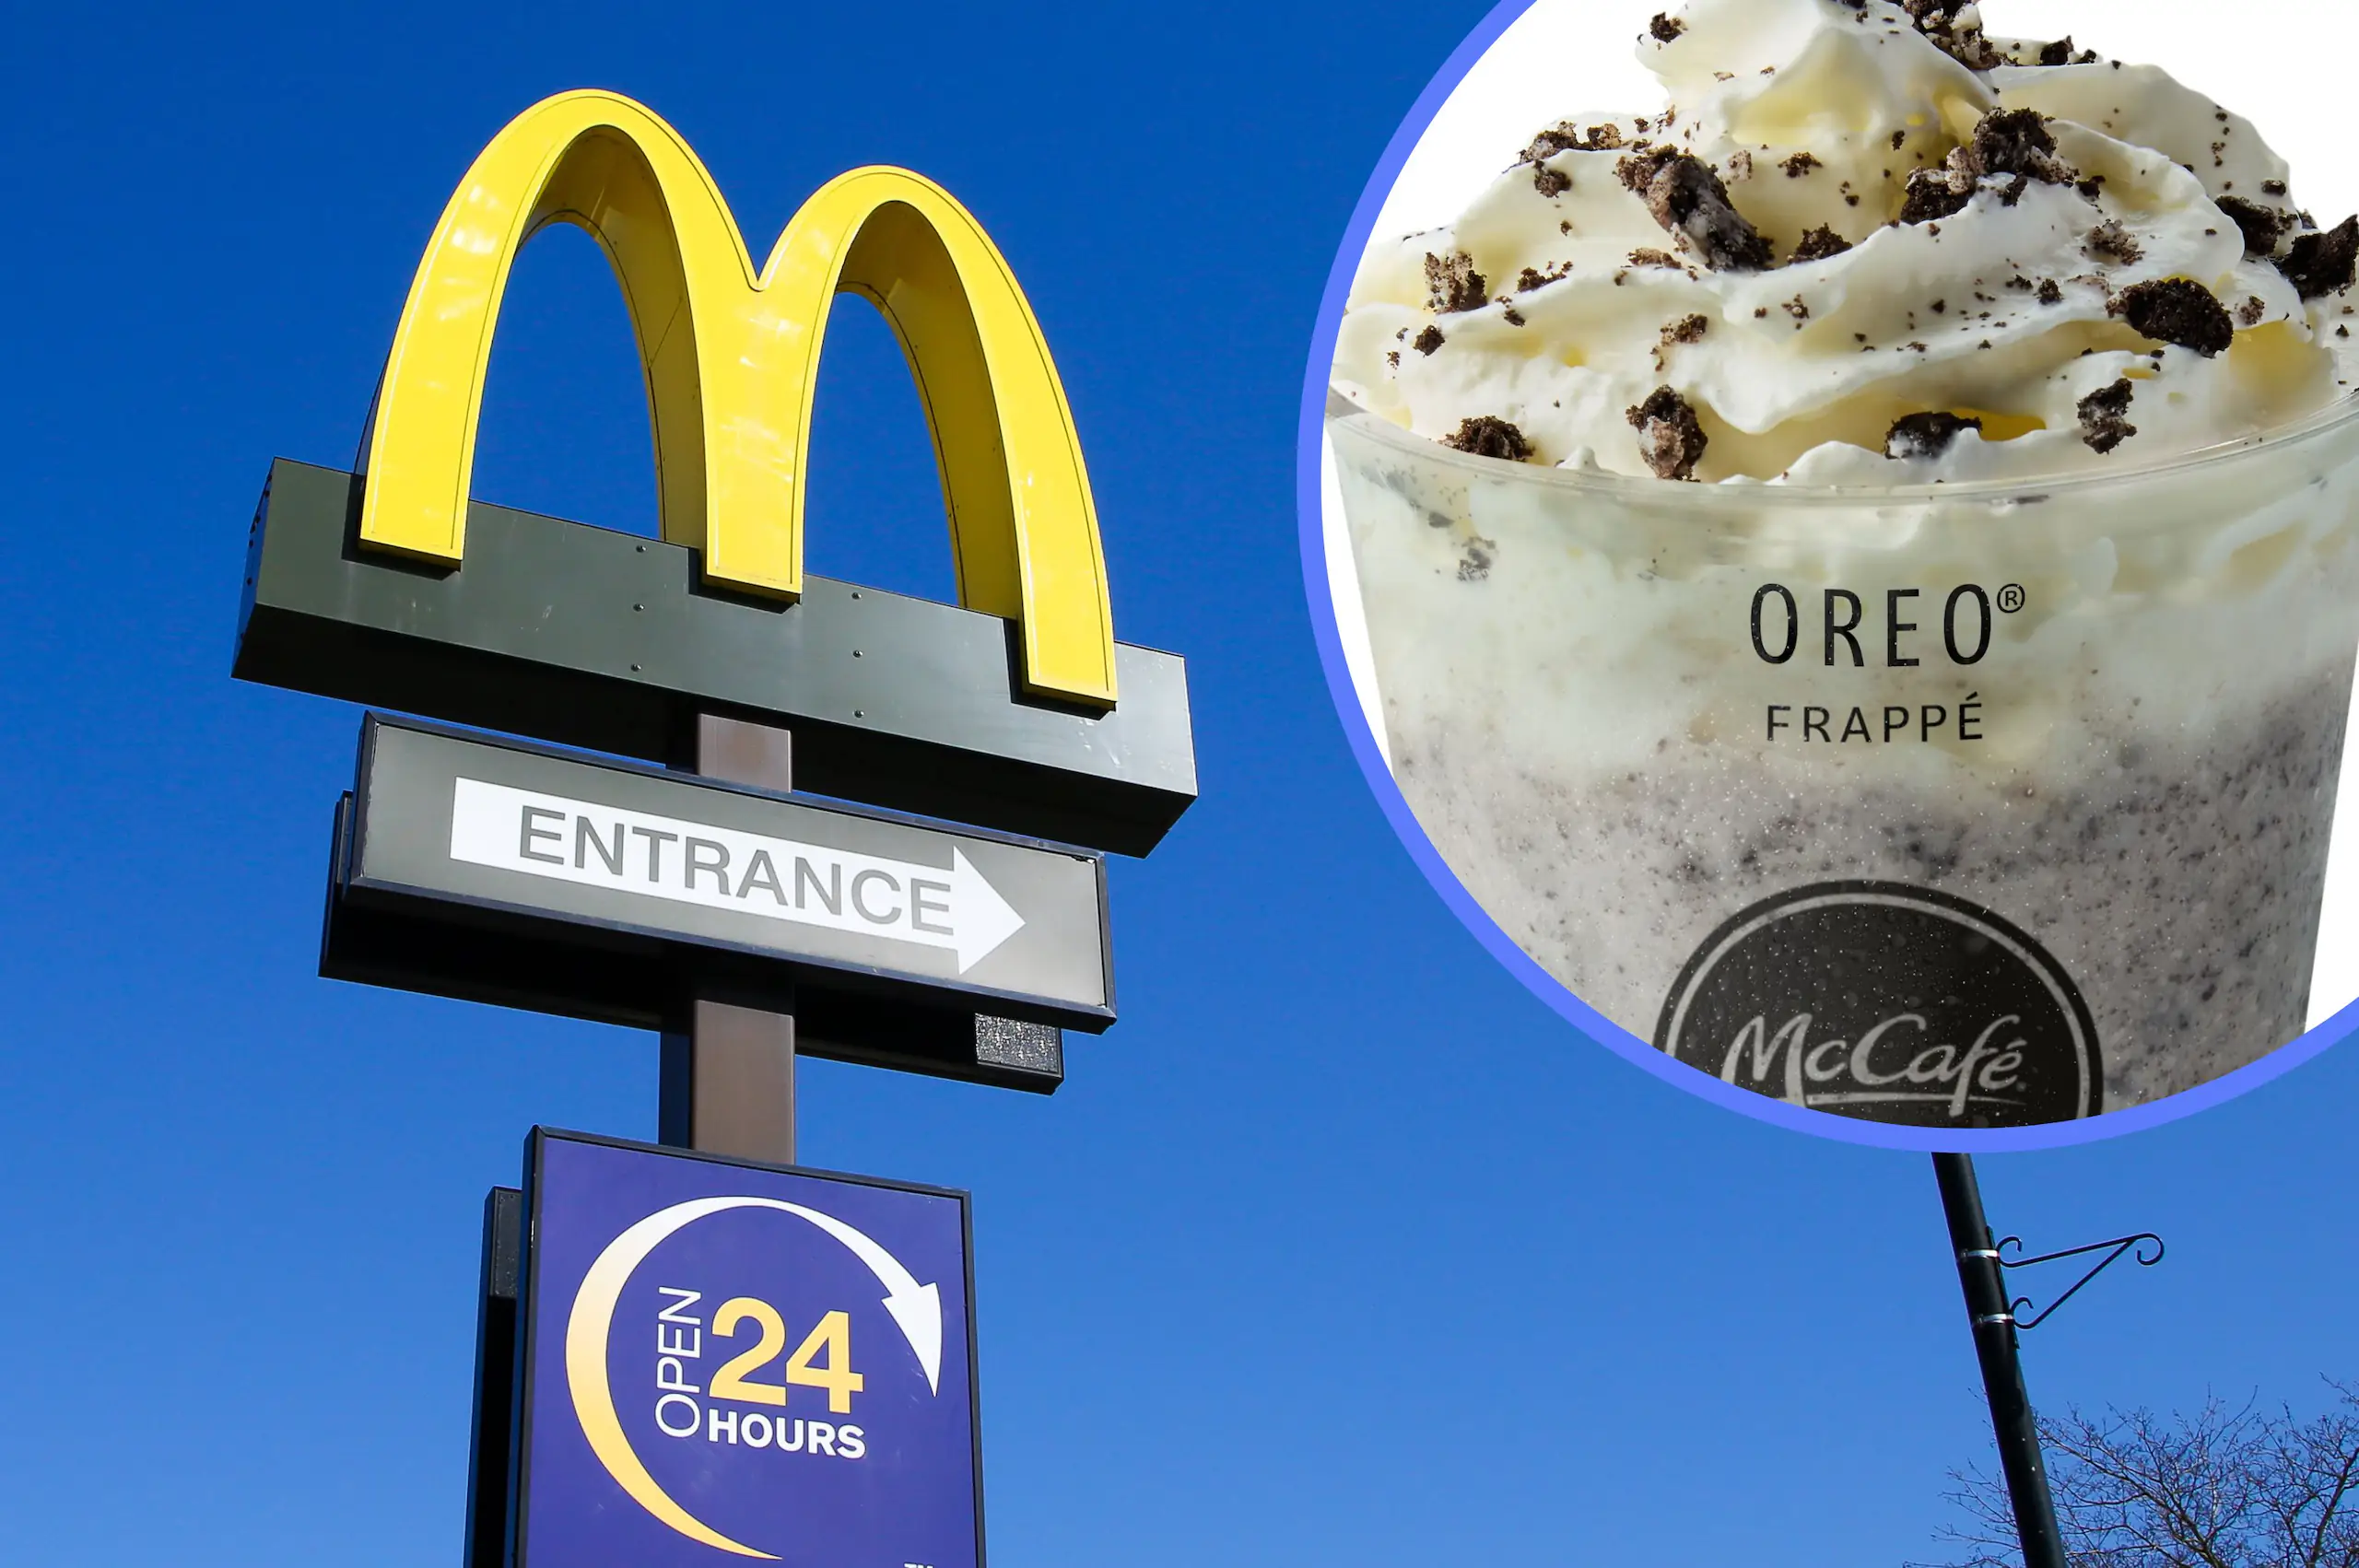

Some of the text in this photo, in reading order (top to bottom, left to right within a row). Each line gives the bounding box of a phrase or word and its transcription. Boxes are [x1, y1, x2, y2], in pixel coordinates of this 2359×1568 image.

[1766, 691, 1983, 743] FRAPPÉ
[519, 805, 955, 937] ENTRANCE
[1720, 1013, 2027, 1117] McCafé
[655, 1286, 701, 1438] OPEN
[709, 1297, 863, 1414] 24
[709, 1408, 866, 1459] HOURS
